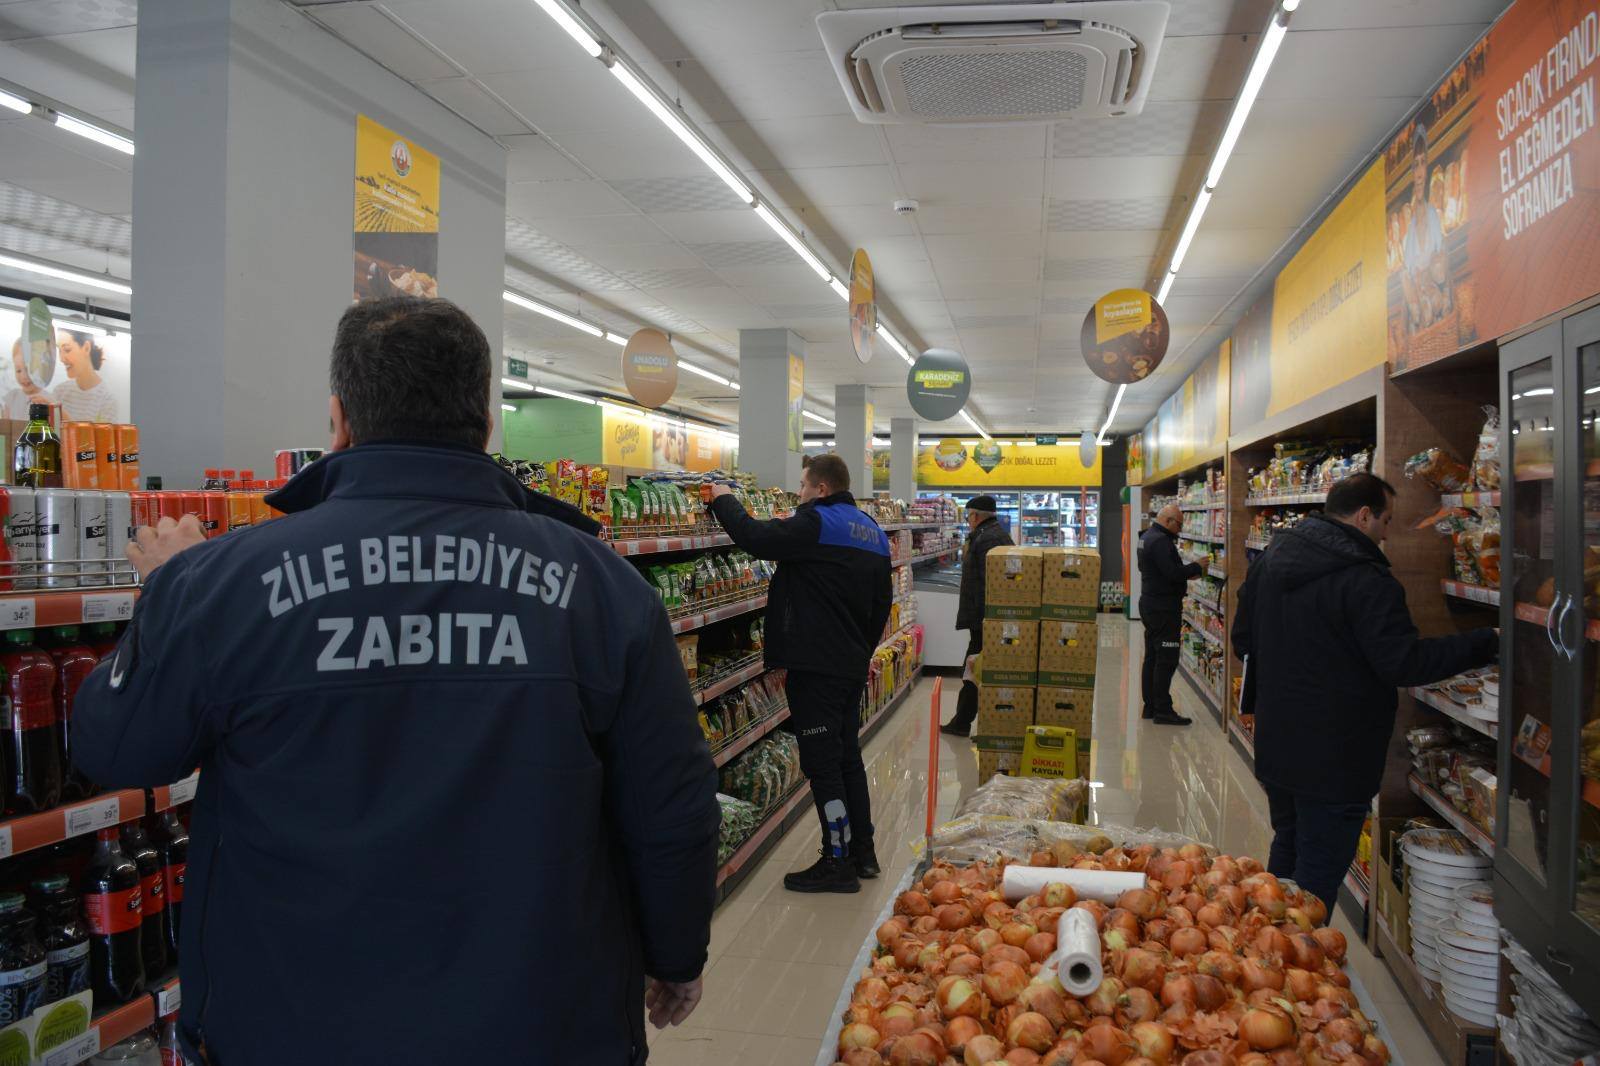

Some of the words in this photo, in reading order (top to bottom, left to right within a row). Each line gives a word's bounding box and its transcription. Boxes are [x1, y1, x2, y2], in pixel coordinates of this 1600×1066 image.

[1497, 59, 1544, 140] SICACIK
[1499, 147, 1516, 193] EL
[1517, 76, 1595, 181] DEĞMEDEN
[1503, 152, 1574, 240] SOFRANIZA
[1036, 457, 1056, 465] LEZZET
[261, 543, 350, 618] ZİLE
[360, 532, 578, 609] BELEDİYESİ
[317, 612, 528, 672] ZABITA
[801, 725, 828, 736] ZABITA
[1032, 767, 1063, 776] KAYGAN
